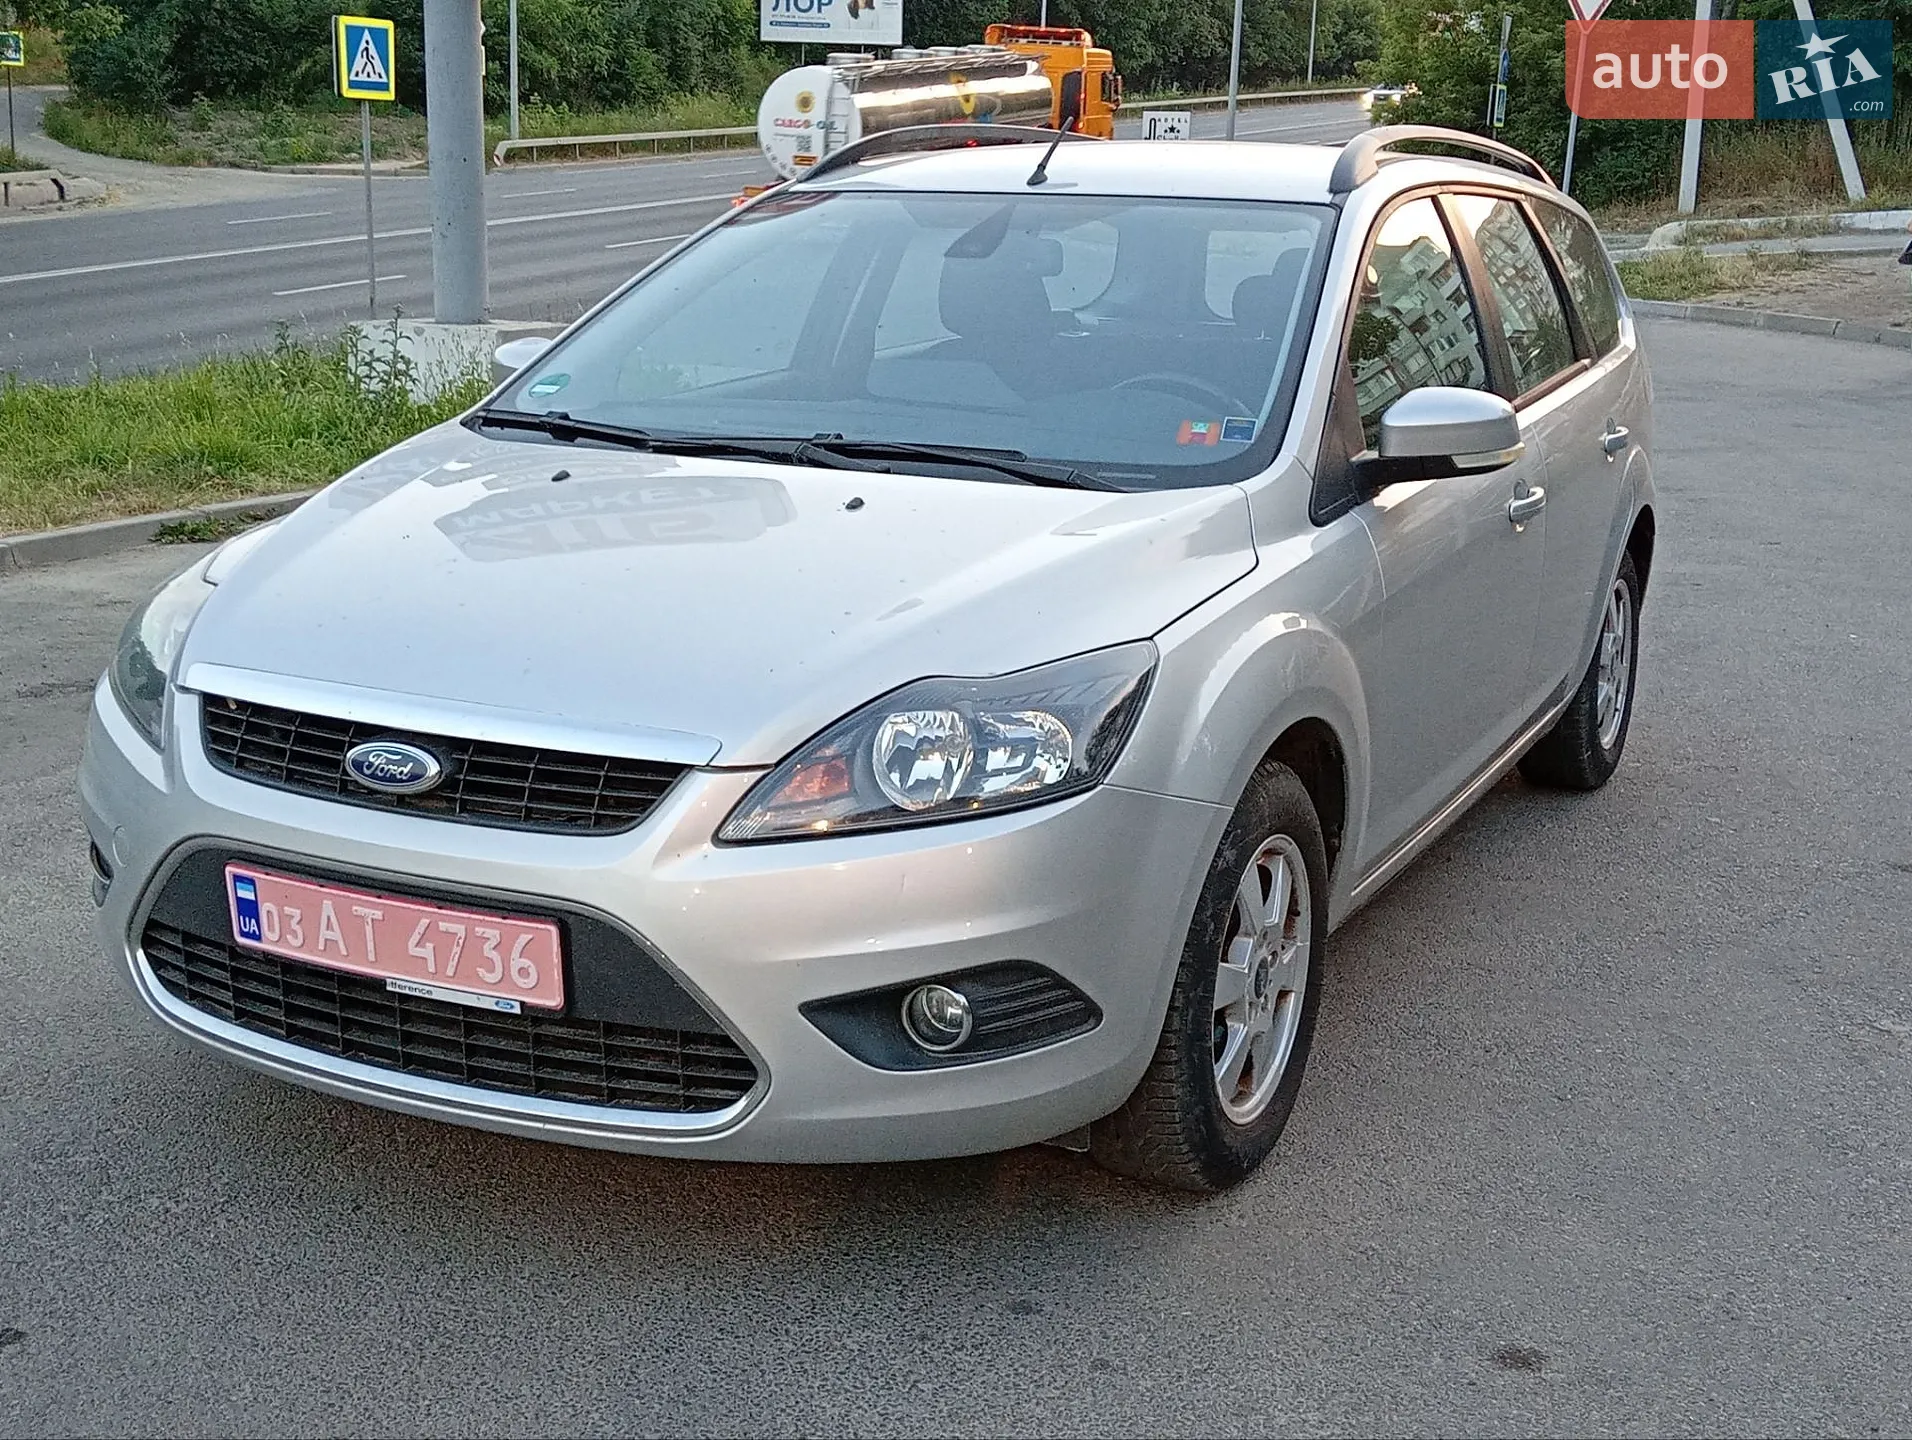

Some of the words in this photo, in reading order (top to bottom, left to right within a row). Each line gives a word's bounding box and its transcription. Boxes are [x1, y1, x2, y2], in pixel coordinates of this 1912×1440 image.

[363, 751, 414, 779] Ford
[240, 918, 259, 936] UA
[261, 902, 304, 947] 03
[318, 900, 384, 962] AT
[407, 918, 539, 989] 4736
